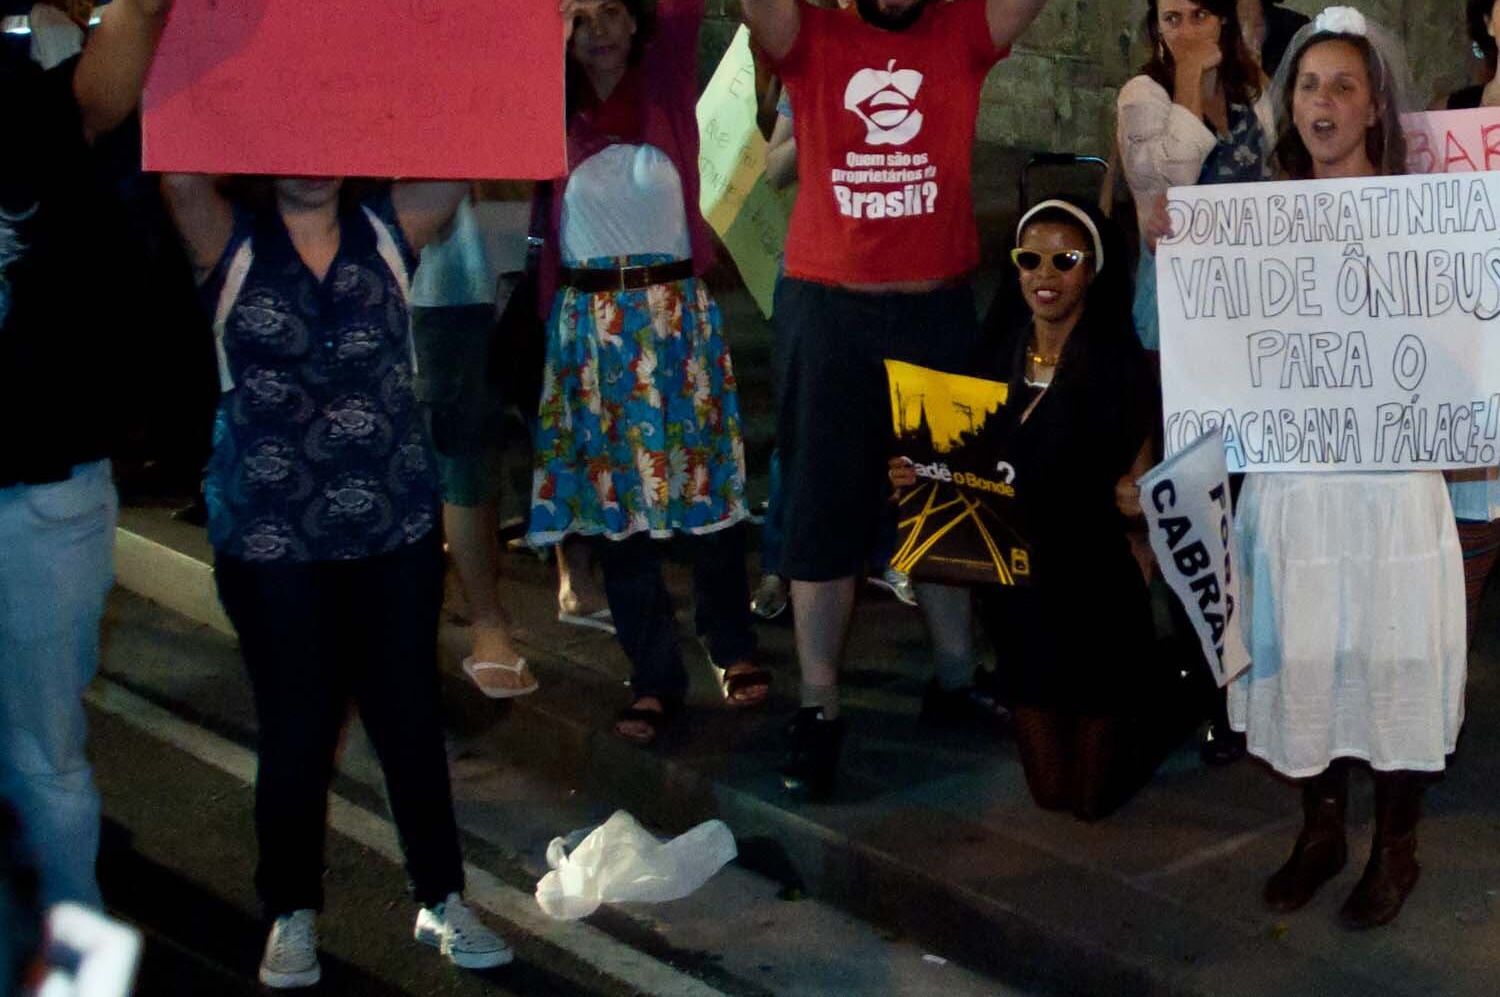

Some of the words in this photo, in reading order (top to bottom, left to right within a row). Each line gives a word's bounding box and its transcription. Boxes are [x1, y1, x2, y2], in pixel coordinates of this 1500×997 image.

[832, 167, 922, 184] proprietários
[846, 151, 885, 168] Quem
[886, 151, 911, 167] são
[912, 152, 928, 165] os
[833, 181, 938, 220] Brasil?
[1163, 198, 1262, 246] DONA
[1171, 256, 1251, 320] VAI
[1260, 257, 1322, 317] DE
[1247, 330, 1373, 389] PARA
[1392, 334, 1427, 391] O
[1374, 393, 1500, 464] PÁLACE!
[966, 472, 1015, 497] Bonde
